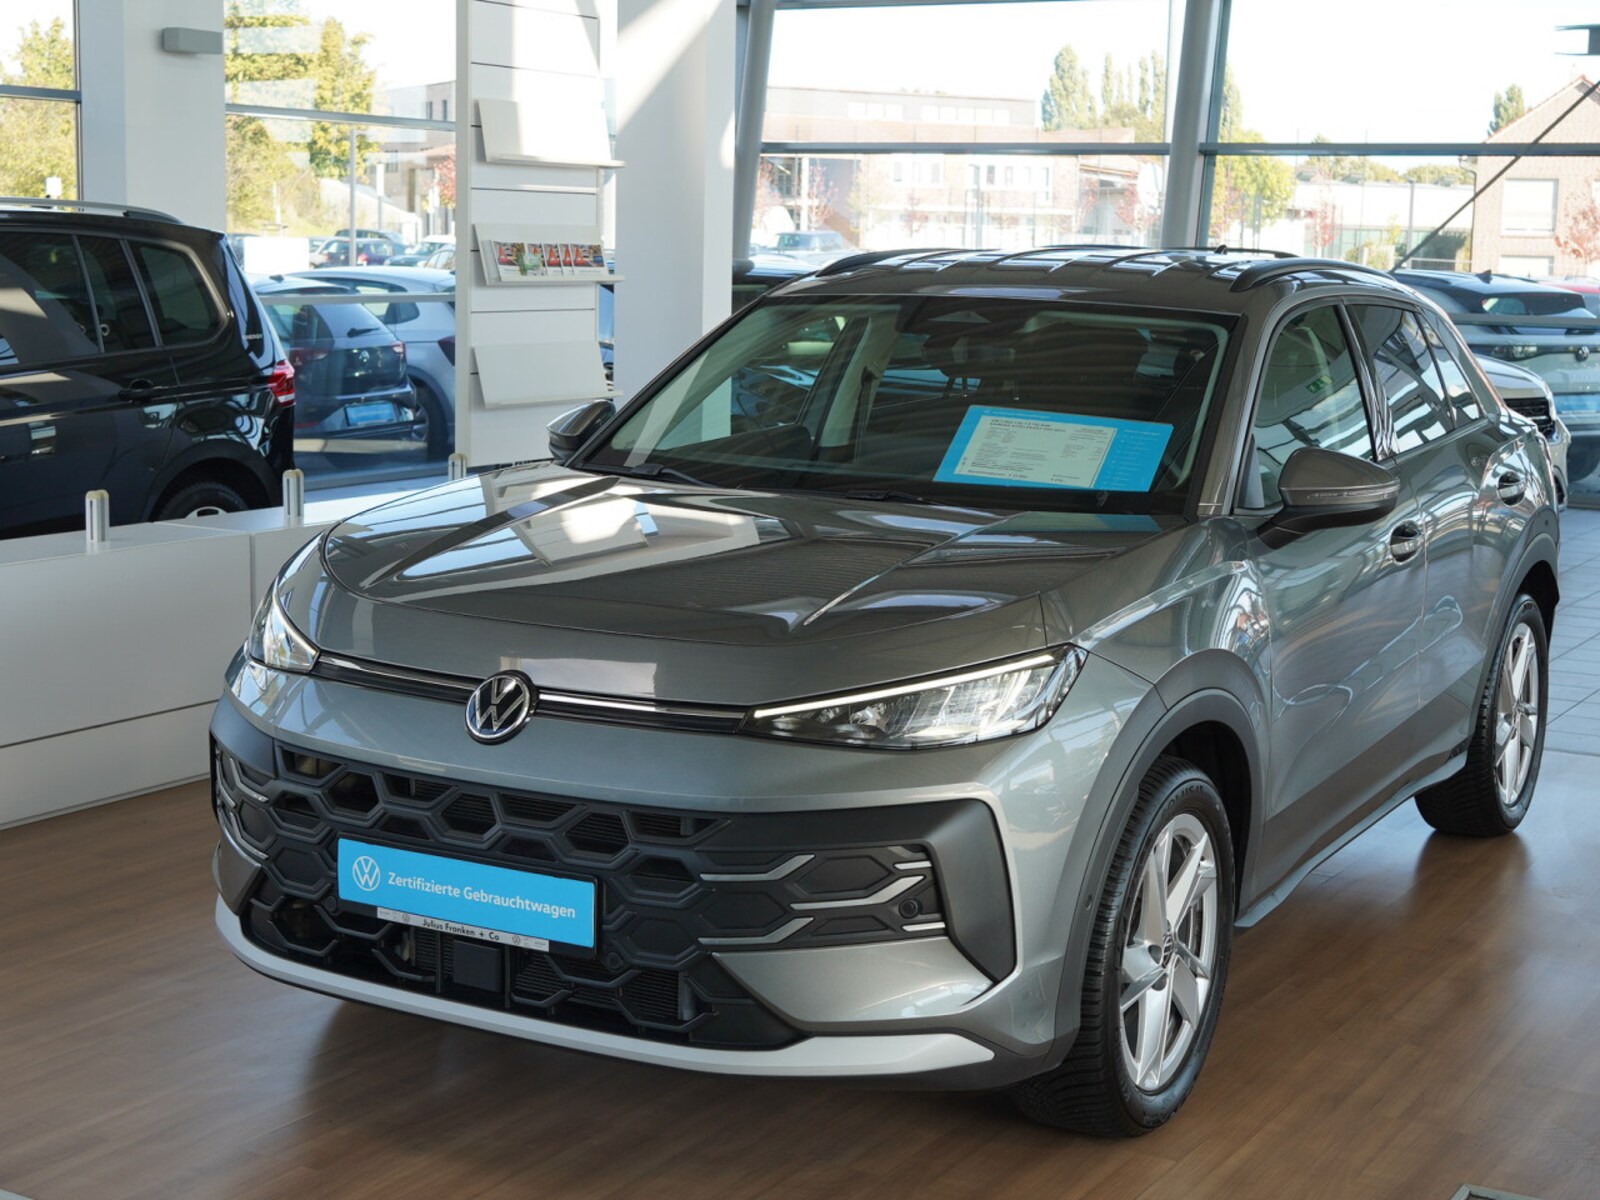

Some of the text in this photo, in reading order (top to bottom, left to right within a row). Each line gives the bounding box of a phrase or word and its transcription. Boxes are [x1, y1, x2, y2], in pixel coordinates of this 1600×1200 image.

[469, 676, 527, 736] VW
[353, 857, 380, 890] VW
[388, 871, 576, 918] Zertifizierte Gebrauchtwagen
[422, 918, 444, 931] Julius
[445, 922, 476, 937] Franken
[488, 931, 500, 941] Co
